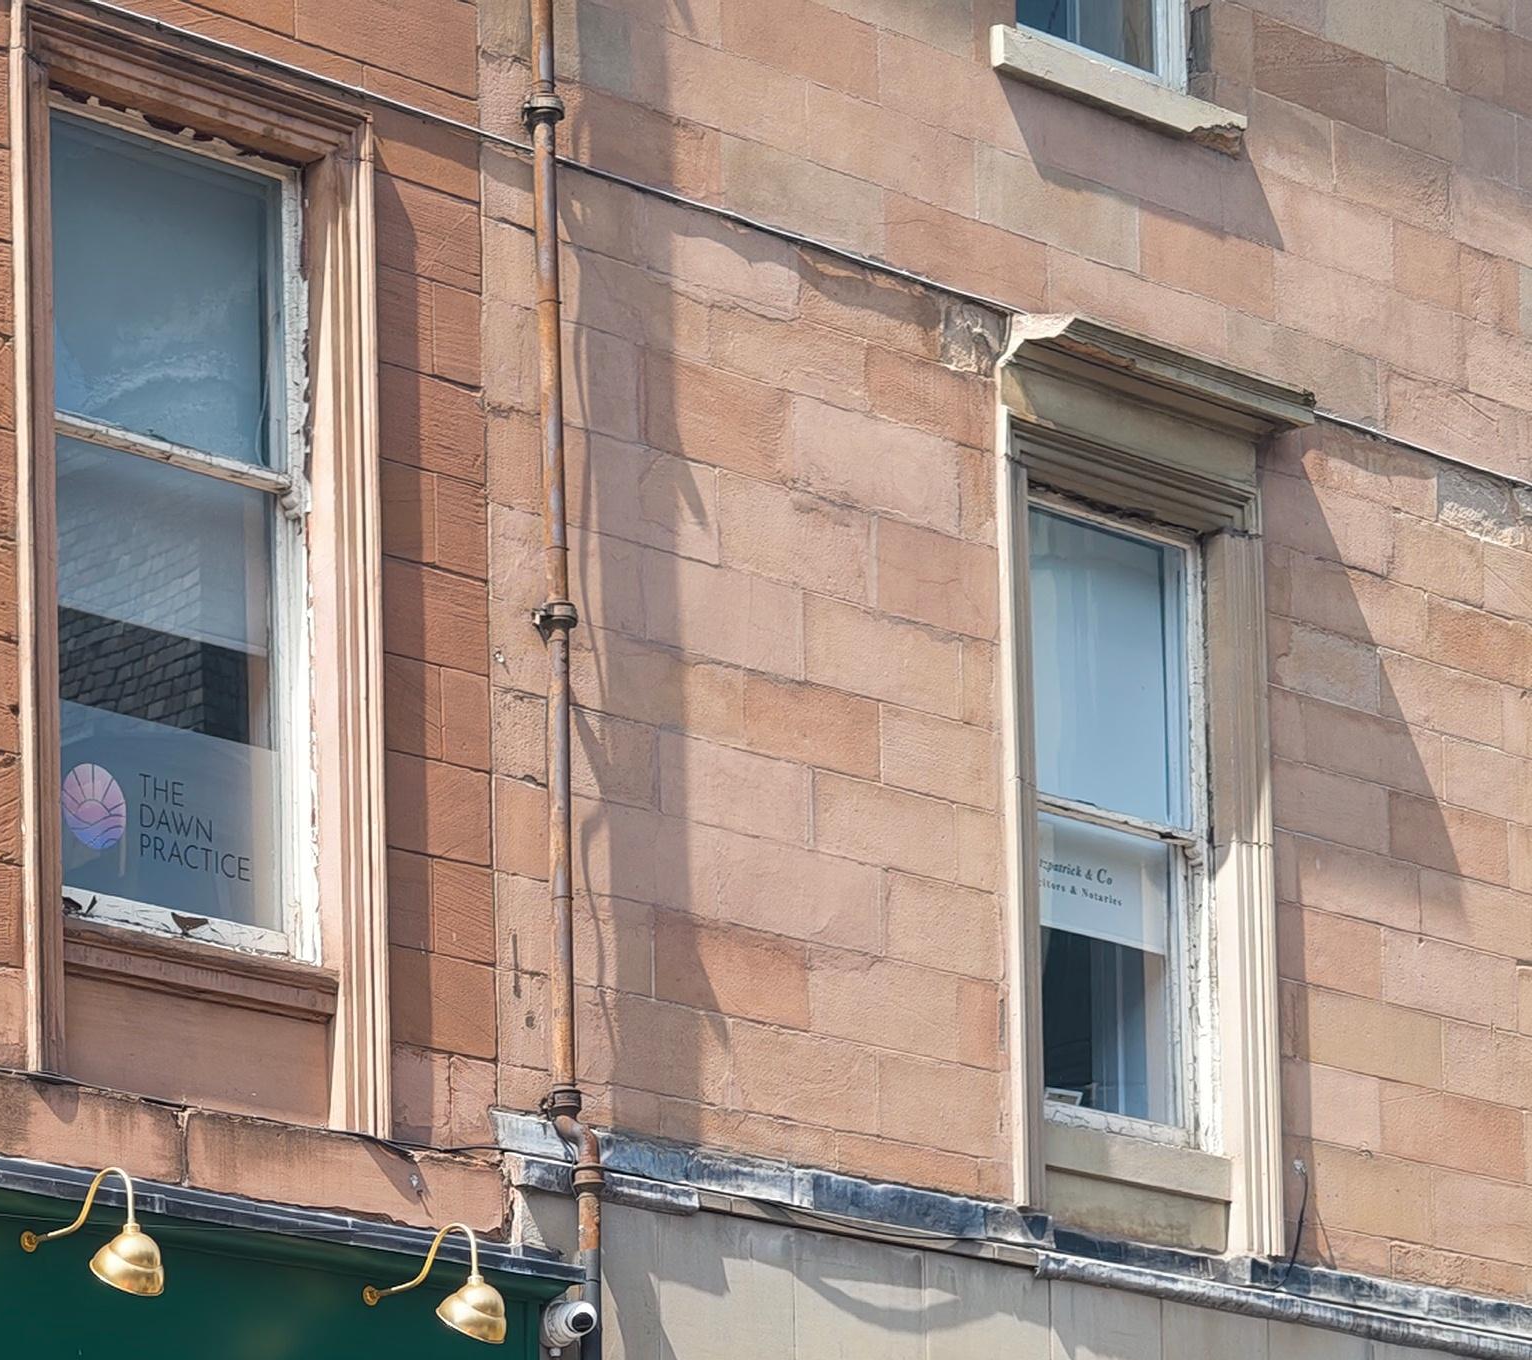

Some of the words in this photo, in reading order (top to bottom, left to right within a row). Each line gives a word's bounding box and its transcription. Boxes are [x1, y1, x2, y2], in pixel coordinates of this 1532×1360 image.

[139, 773, 185, 807] THE
[139, 804, 213, 843] DAWN
[139, 834, 251, 882] PRACTICE
[1084, 868, 1093, 881] &
[1097, 868, 1113, 885] Co
[1070, 886, 1077, 895] &
[1082, 888, 1123, 906] Notaries
